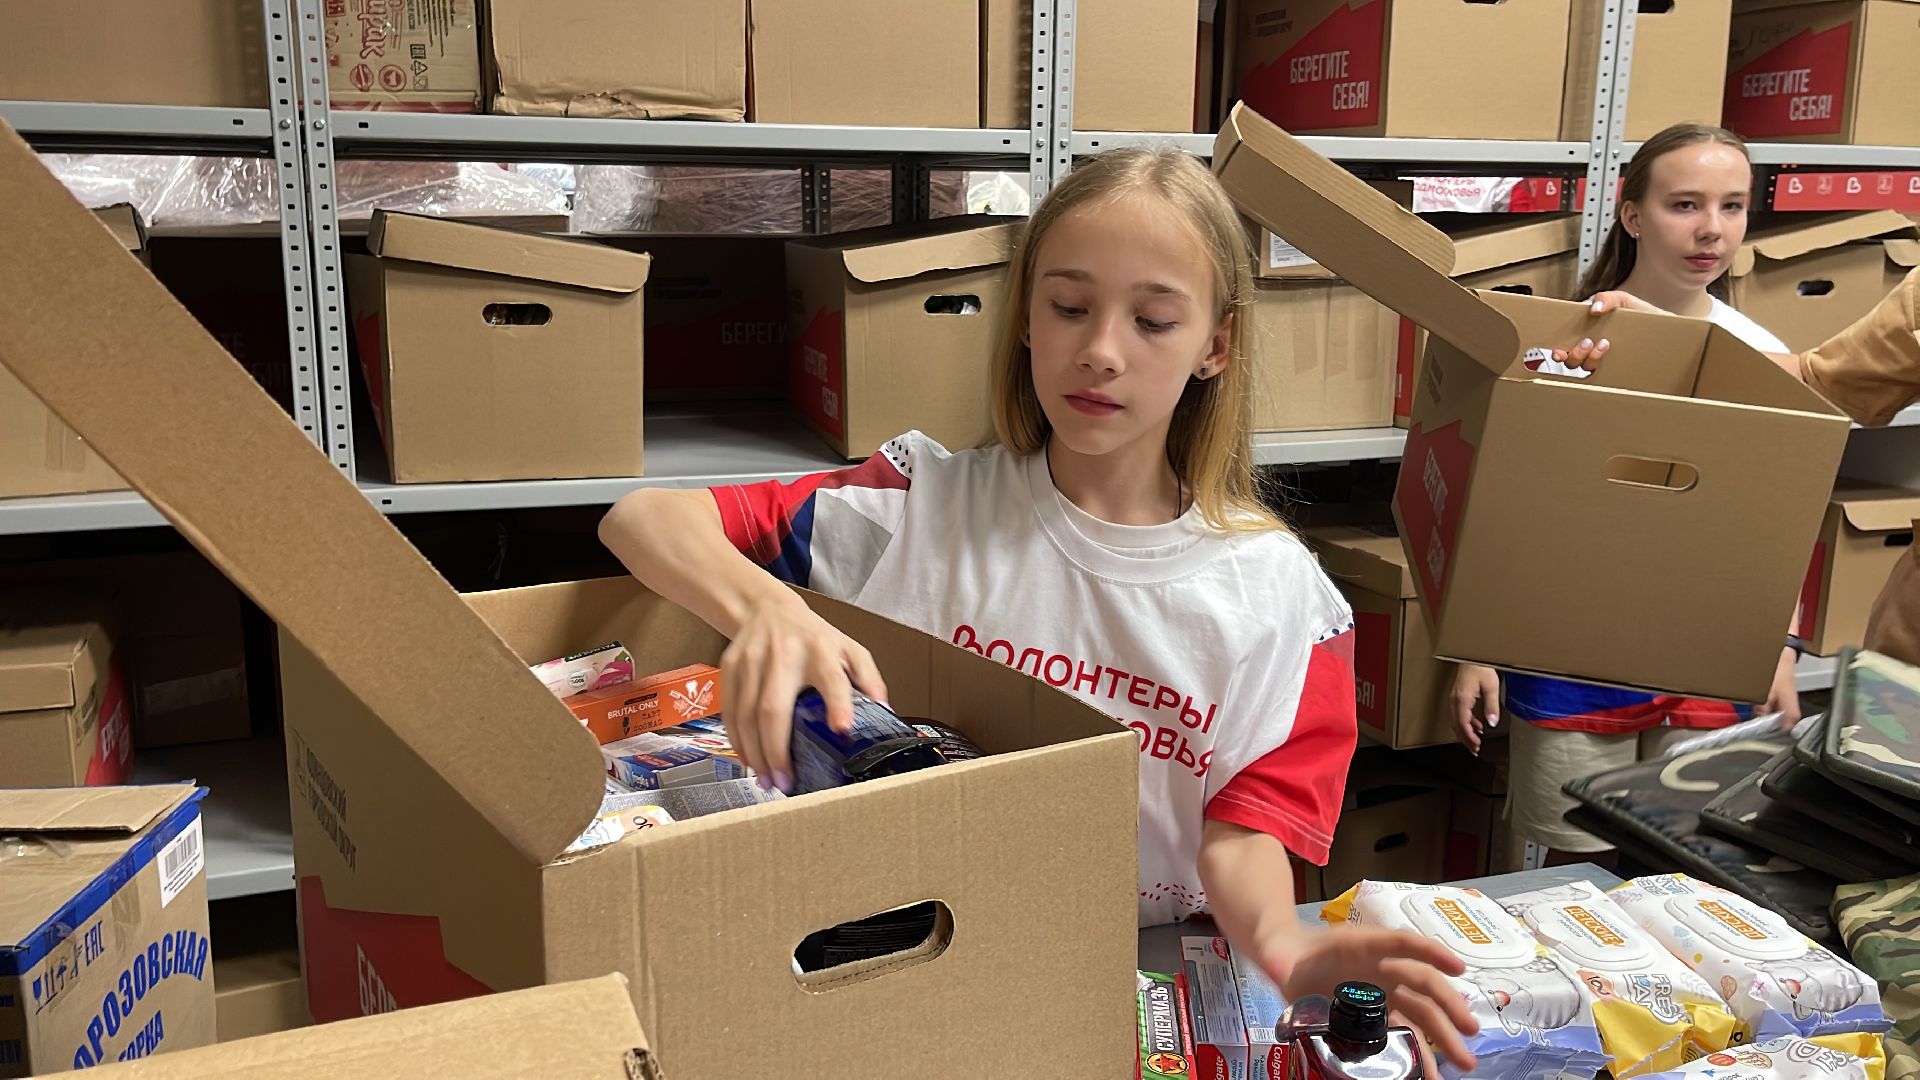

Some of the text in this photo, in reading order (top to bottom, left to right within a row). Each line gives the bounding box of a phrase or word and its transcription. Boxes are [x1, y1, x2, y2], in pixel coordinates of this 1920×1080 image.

[1289, 50, 1350, 84] БЕРЕГИТЕ
[1741, 68, 1812, 98] БЕРЕГИТЕ
[1331, 80, 1370, 111] СЕБЯ!
[1788, 94, 1833, 122] СЕБЯ!
[607, 707, 639, 720] BRUTAL
[639, 699, 660, 711] ONLY
[1437, 900, 1489, 943] ДЕТСКИЕ
[1565, 907, 1617, 943] ДЕТСКИЕ
[1703, 902, 1764, 939] ДЕТСКИЕ
[73, 929, 209, 1070] ОРОЗОВСКАЯ
[1150, 986, 1175, 1051] СУПЕРМАЗЬ
[1213, 1056, 1225, 1080] gate
[1271, 1046, 1283, 1080] Colgat
